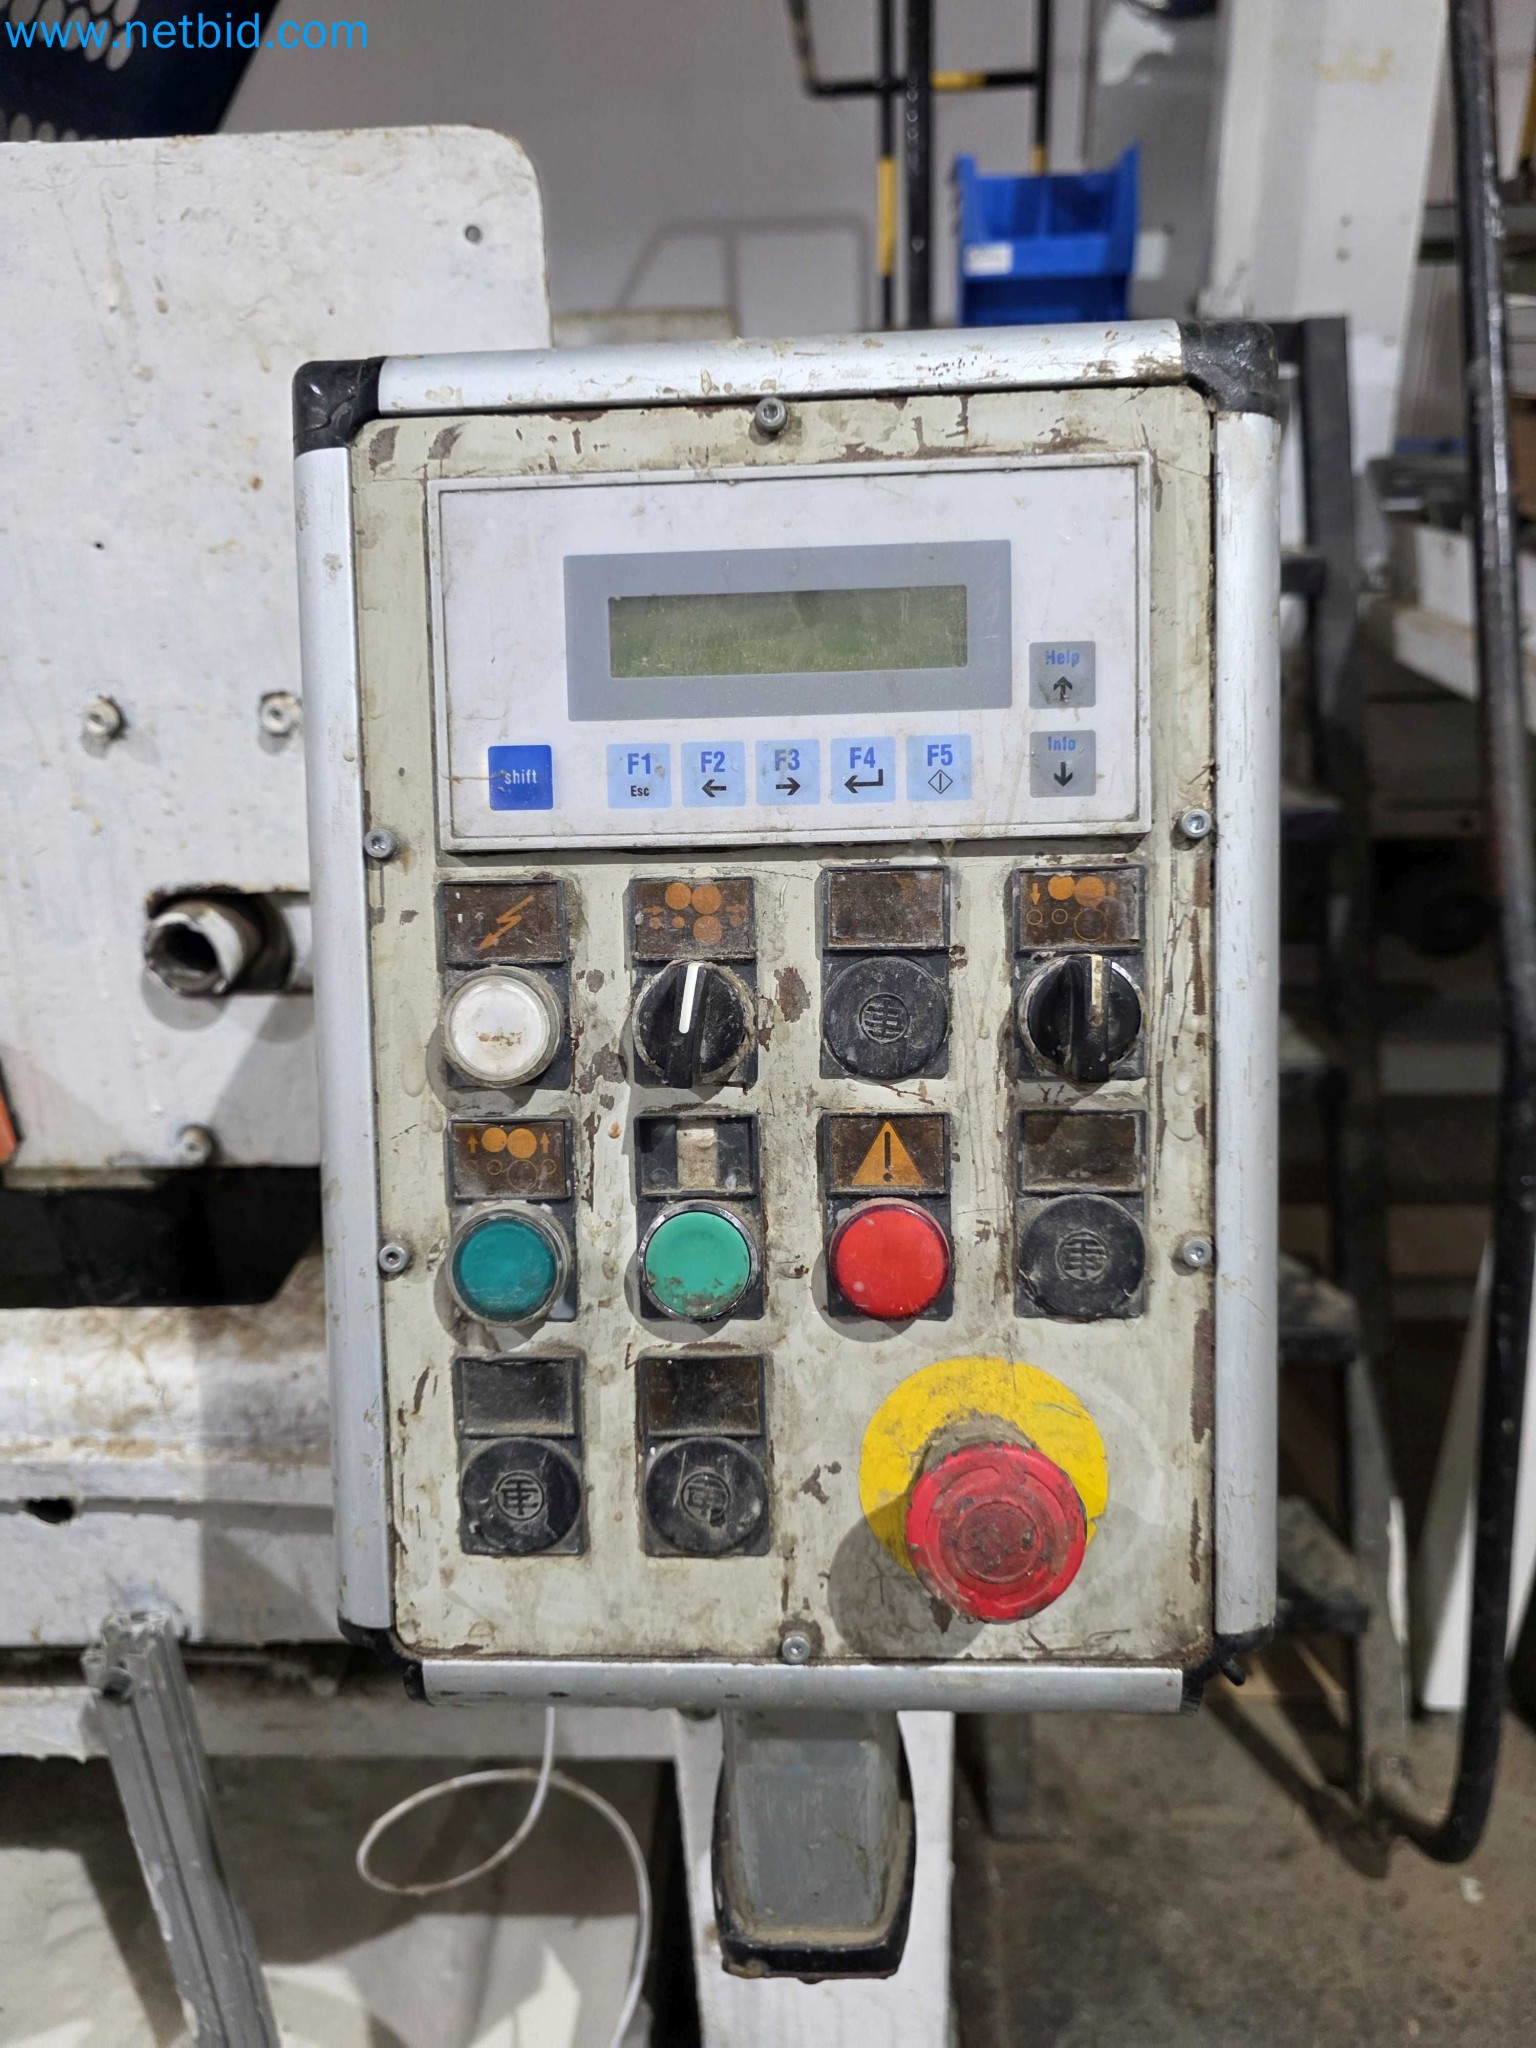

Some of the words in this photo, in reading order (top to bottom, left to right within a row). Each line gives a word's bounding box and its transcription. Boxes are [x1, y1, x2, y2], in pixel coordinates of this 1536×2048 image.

[1045, 650, 1080, 667] Help
[1047, 736, 1077, 751] Info
[627, 753, 651, 775] F1
[700, 751, 726, 773] F2
[774, 748, 801, 771] F3
[849, 747, 876, 768] F4
[927, 744, 953, 766] F5
[504, 768, 537, 785] shift
[630, 785, 650, 797] Esc
